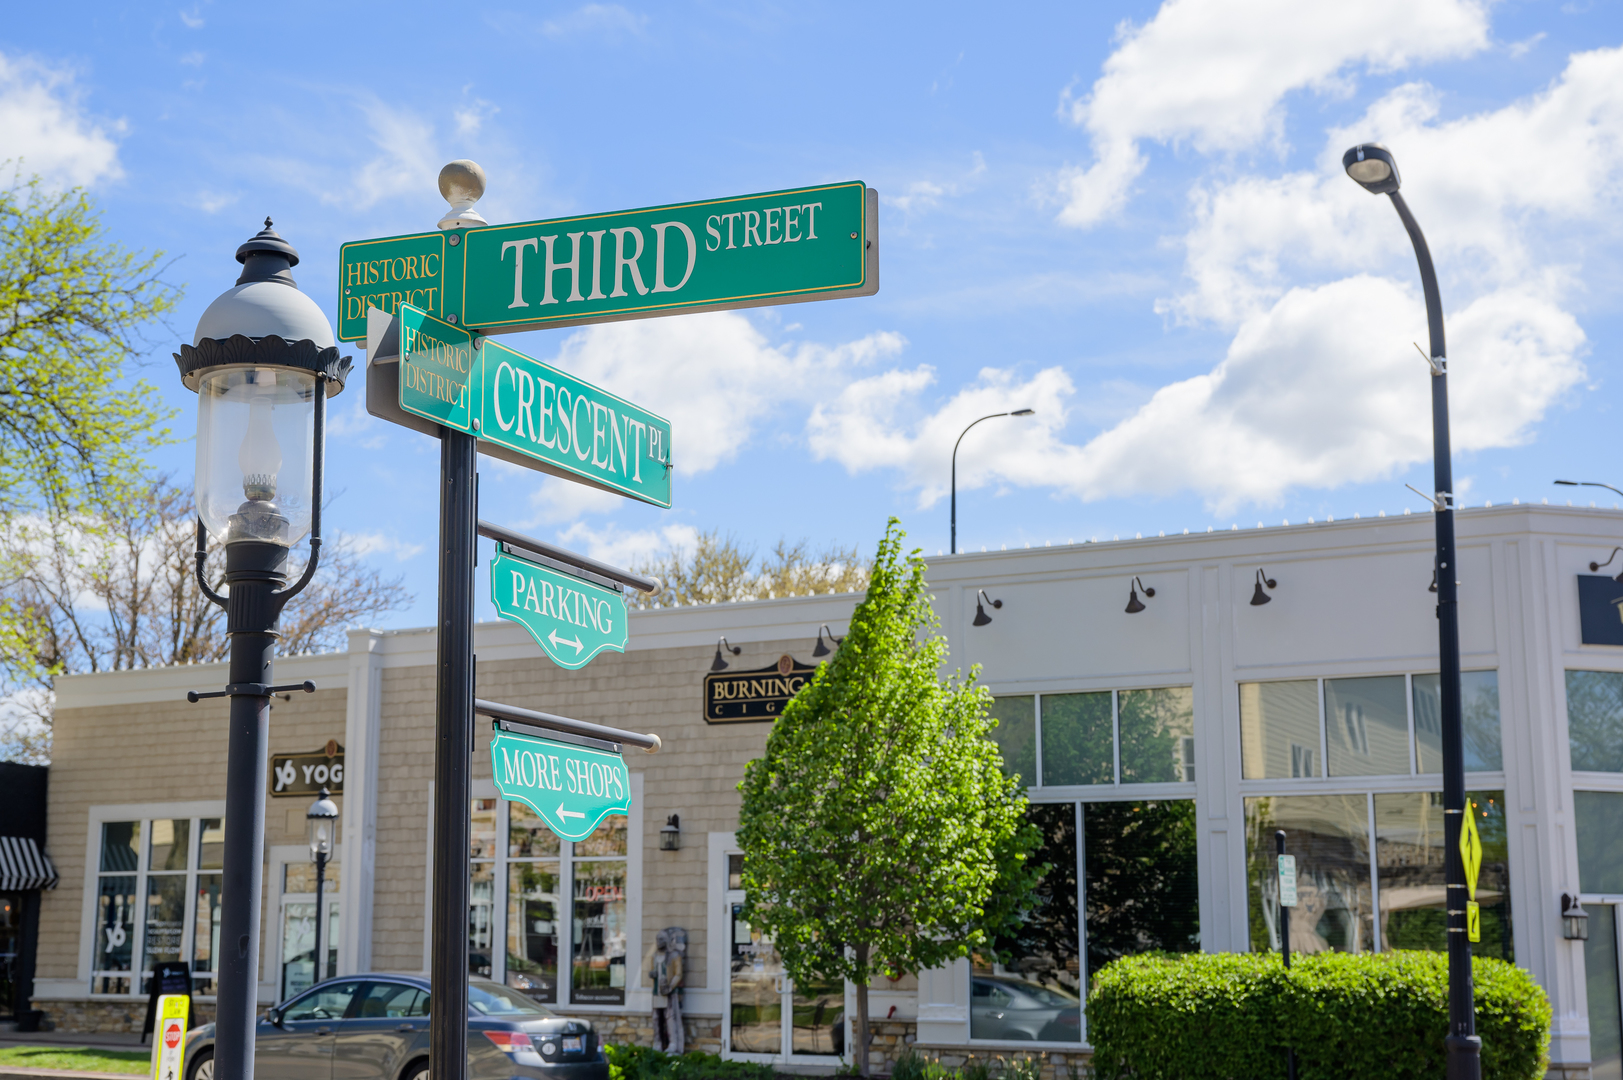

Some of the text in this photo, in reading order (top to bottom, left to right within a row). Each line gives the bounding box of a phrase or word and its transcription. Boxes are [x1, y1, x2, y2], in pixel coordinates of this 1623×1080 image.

[346, 253, 440, 287] HISTORIC
[501, 202, 822, 309] THIRD STREET
[404, 325, 468, 374] HISTORIC
[406, 362, 467, 409] DISTRICT
[493, 361, 667, 484] CRESCENT PL
[510, 569, 613, 635] PARKING
[712, 676, 805, 700] BURNING
[301, 763, 344, 785] YOG
[501, 747, 624, 801] MORE SHOPS
[585, 886, 623, 902] OPEN
[166, 1031, 181, 1042] STOP
